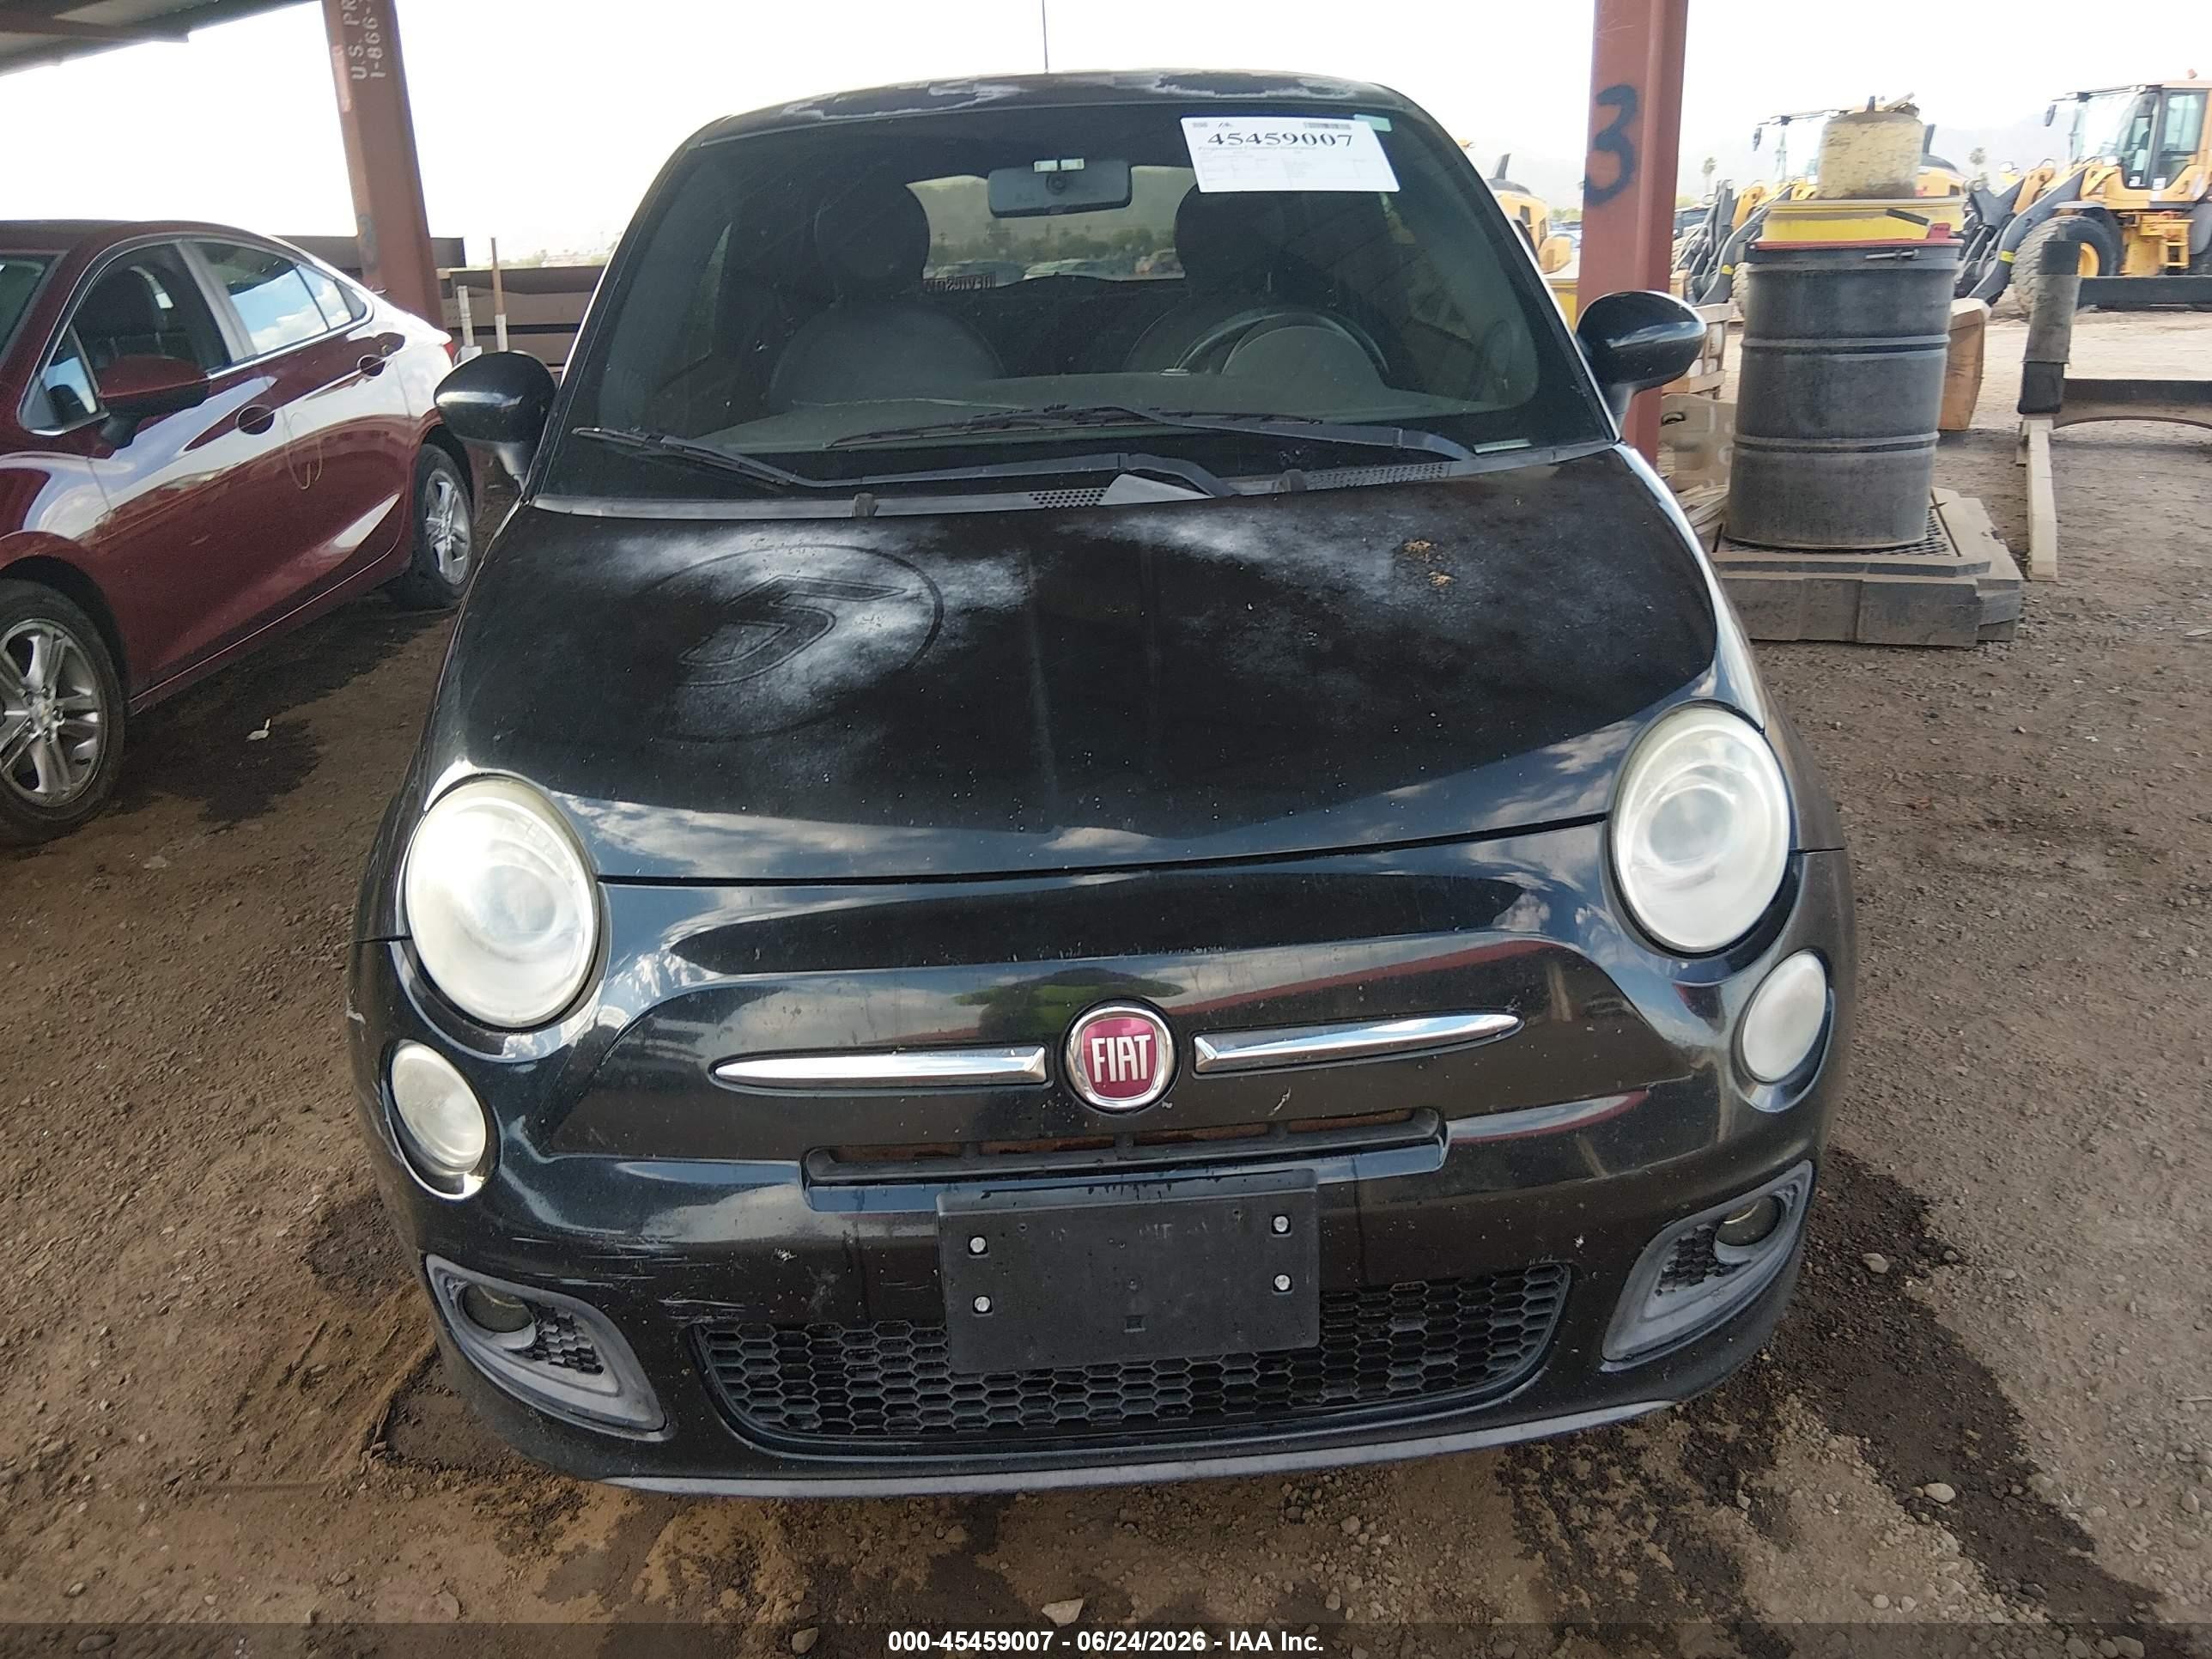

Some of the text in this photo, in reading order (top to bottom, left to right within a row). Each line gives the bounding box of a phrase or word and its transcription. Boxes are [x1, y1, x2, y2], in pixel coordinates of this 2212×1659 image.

[361, 0, 386, 77] 1-866-
[1207, 131, 1353, 148] 45459007
[1583, 82, 1638, 207] 3
[1091, 1034, 1152, 1084] FIAT
